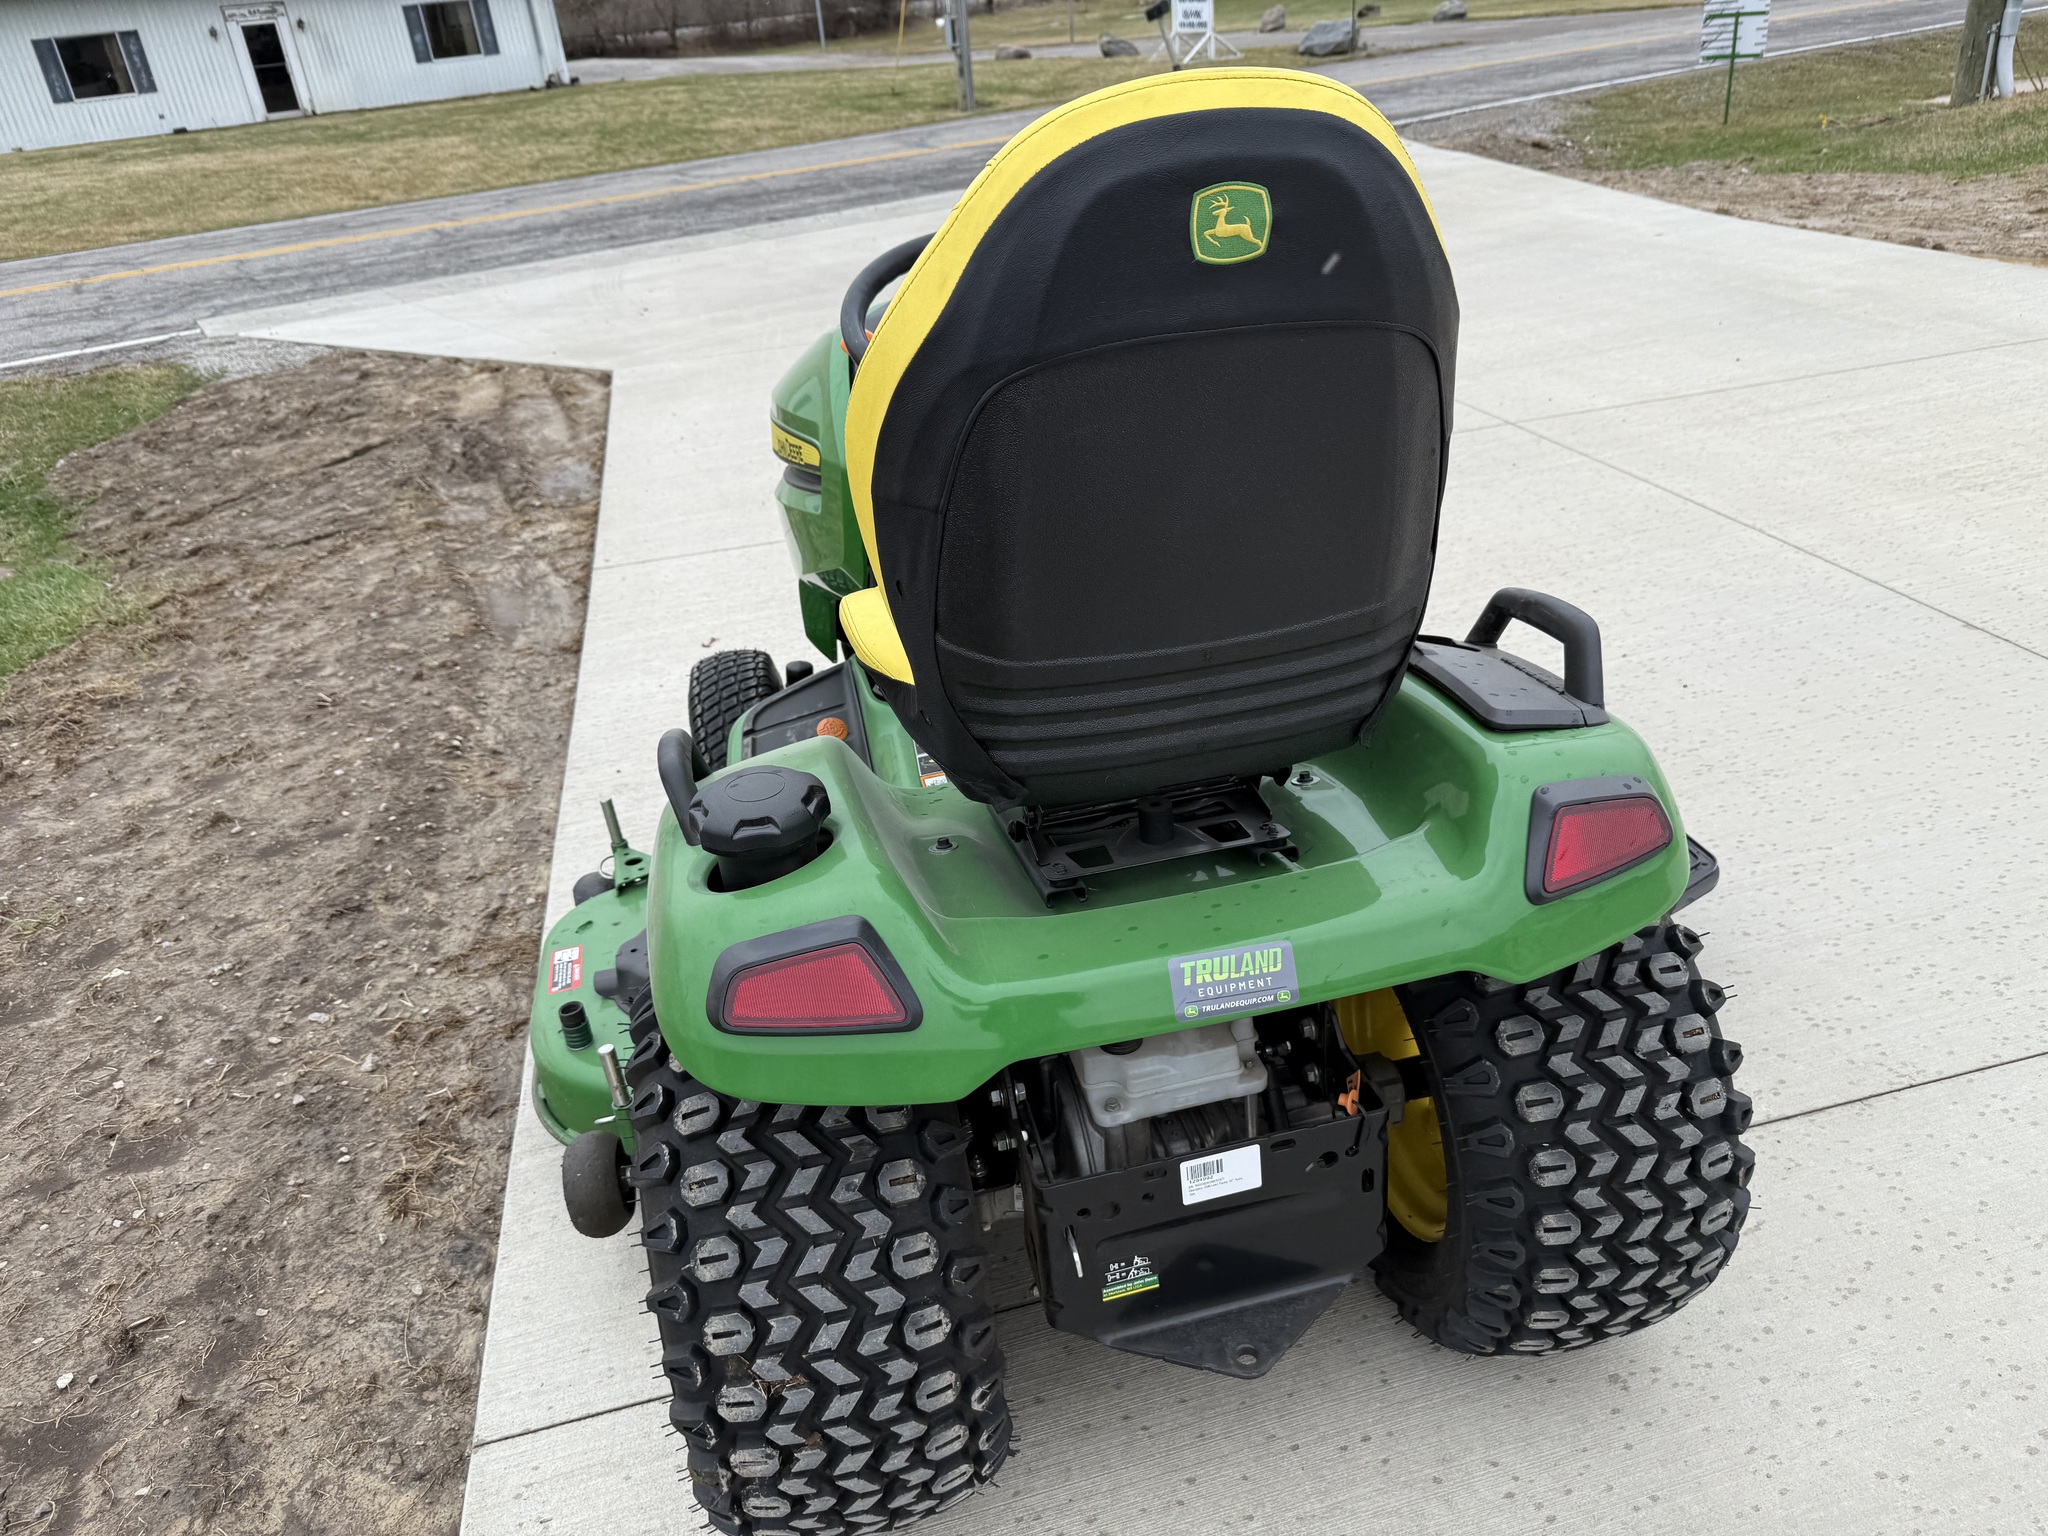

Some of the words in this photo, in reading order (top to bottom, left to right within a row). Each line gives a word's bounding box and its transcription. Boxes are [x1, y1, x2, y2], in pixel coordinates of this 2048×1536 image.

[1180, 947, 1282, 986] TRULAND
[1198, 977, 1273, 997] EQUIPMENT
[1202, 996, 1273, 1012] TRULANDEQUIP.COM
